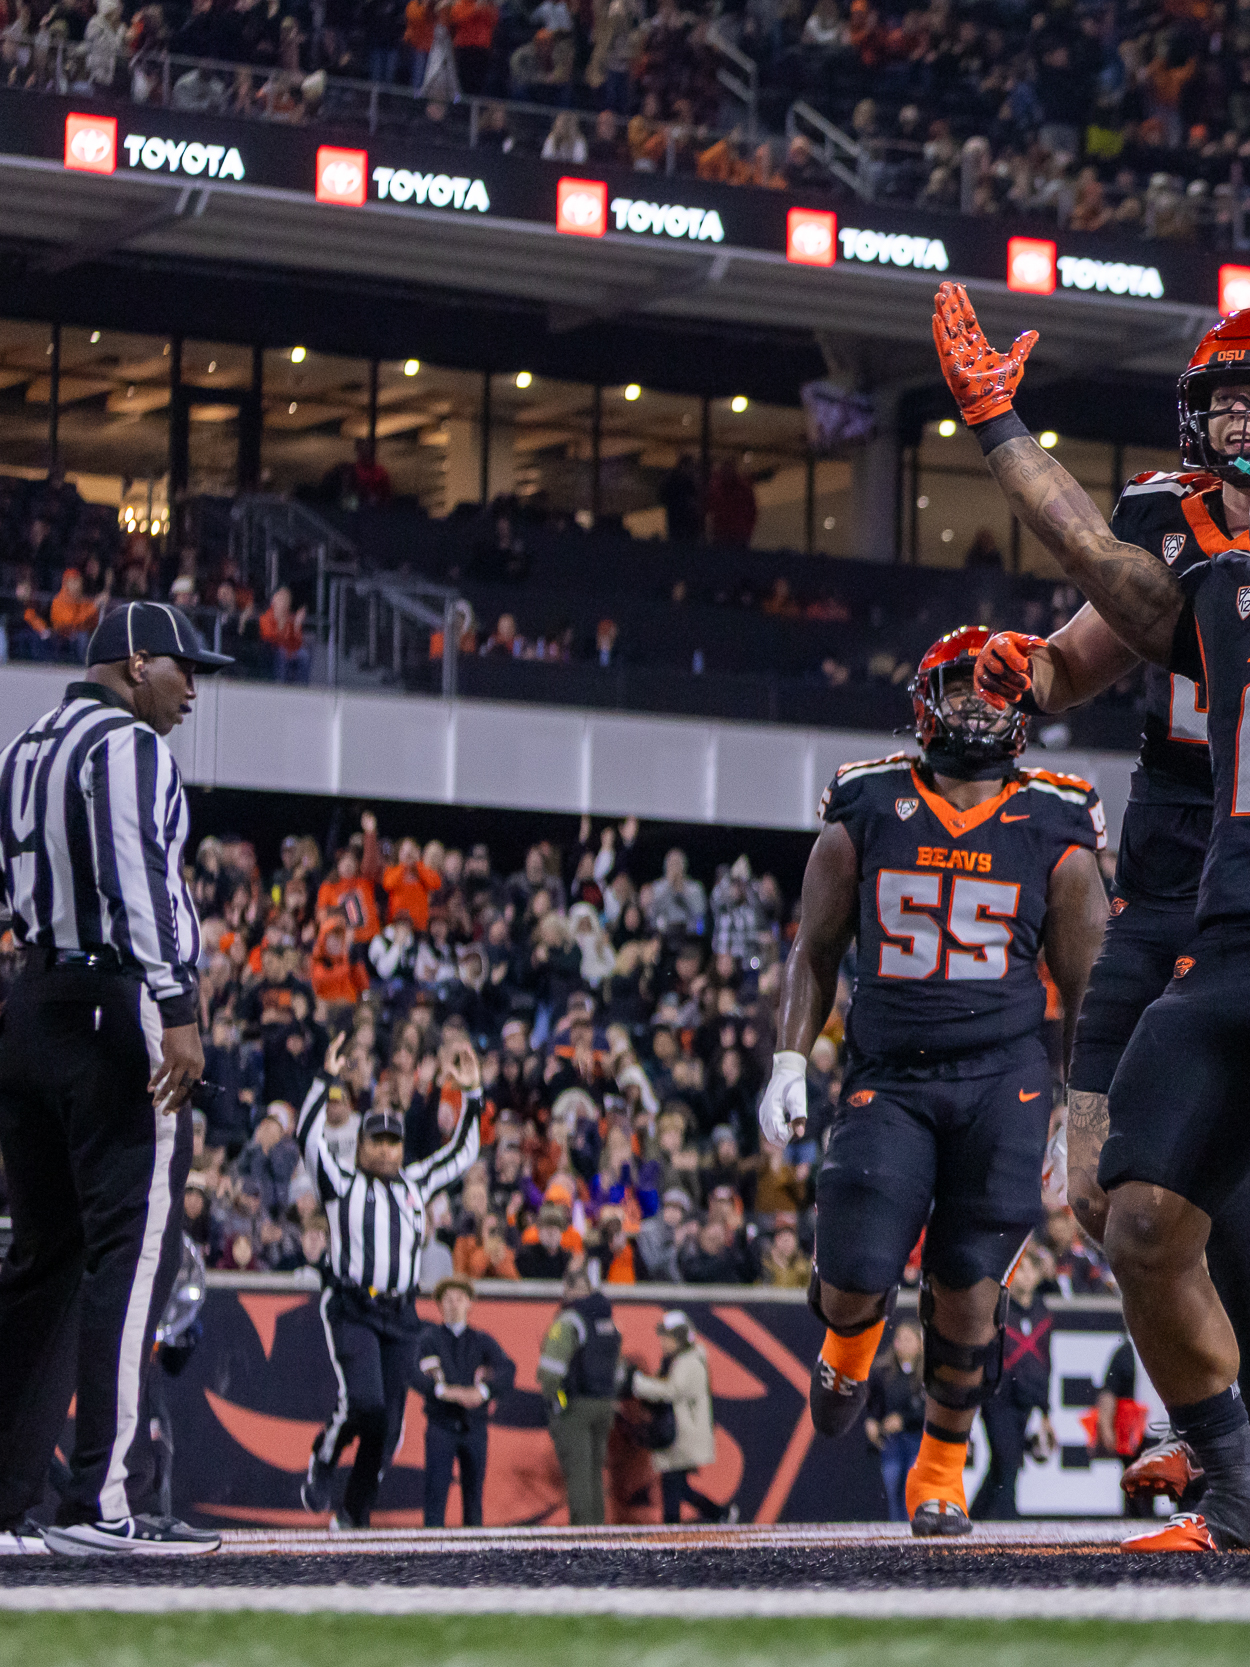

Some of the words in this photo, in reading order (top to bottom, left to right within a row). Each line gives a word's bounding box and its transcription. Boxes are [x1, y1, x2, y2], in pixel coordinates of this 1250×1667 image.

[124, 135, 245, 181] TOYOTA
[372, 166, 490, 212] TOYOTA
[610, 198, 724, 242] TOYOTA
[838, 228, 950, 271] TOYOTA
[1057, 256, 1164, 298] TOYOTA
[1217, 349, 1246, 362] OSU
[916, 846, 992, 873] BEAVS
[876, 868, 1021, 981] 55
